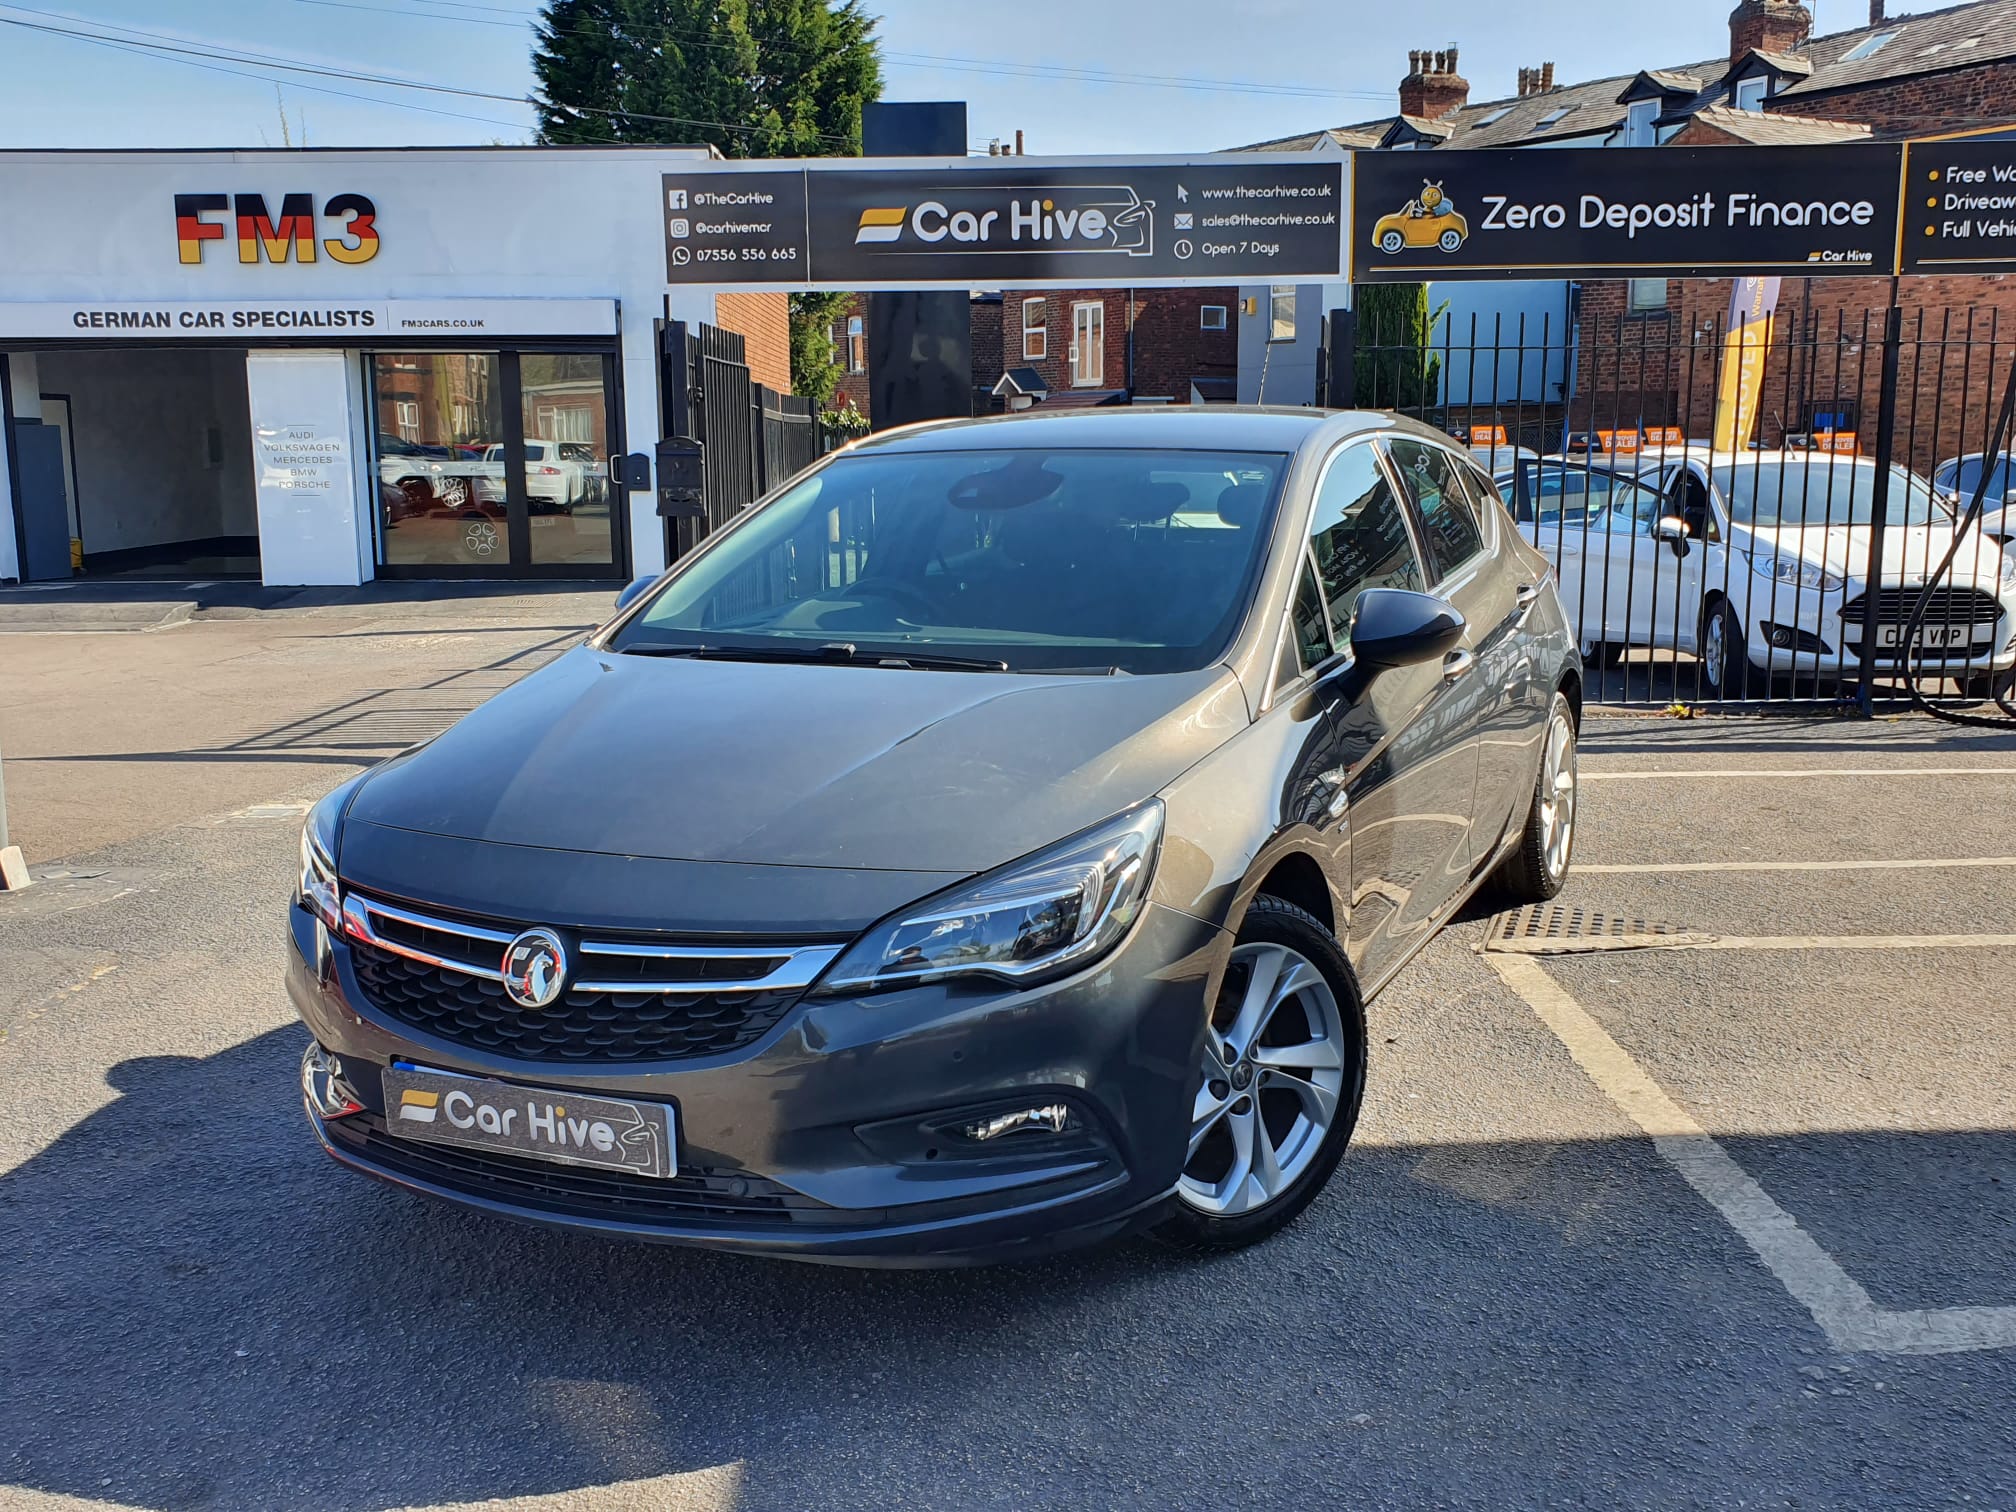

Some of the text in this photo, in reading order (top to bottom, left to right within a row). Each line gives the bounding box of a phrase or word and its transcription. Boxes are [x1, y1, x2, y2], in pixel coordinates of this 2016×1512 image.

[1946, 166, 1987, 184] Free
[694, 192, 774, 206] @TheCarHive
[1202, 184, 1332, 199] www.thecarhive.co.uk
[1944, 193, 2016, 210] Driveaw
[911, 199, 1108, 242] Car Hive
[1202, 211, 1336, 227] sales@thecarhive.co.uk
[1481, 192, 1874, 239] Zero Deposit Finance
[174, 193, 380, 264] FM3
[695, 221, 772, 234] @carhivemcr
[1942, 219, 2016, 238] Full Vehi
[697, 248, 796, 261] 07556 556 665
[1202, 241, 1280, 258] Open 7 Days
[1822, 249, 1872, 261] Car Hive
[73, 310, 375, 328] GERMAN CAR SPECIALISTS
[401, 319, 485, 328] FM3CARS.CO.UK
[288, 431, 314, 439] AUDI
[263, 444, 340, 452] VOLKSWAGEN
[273, 456, 333, 464] MERCEDES
[290, 468, 317, 476] BMW
[279, 480, 331, 489] PORSCHE
[444, 1090, 616, 1151] Car Hive
